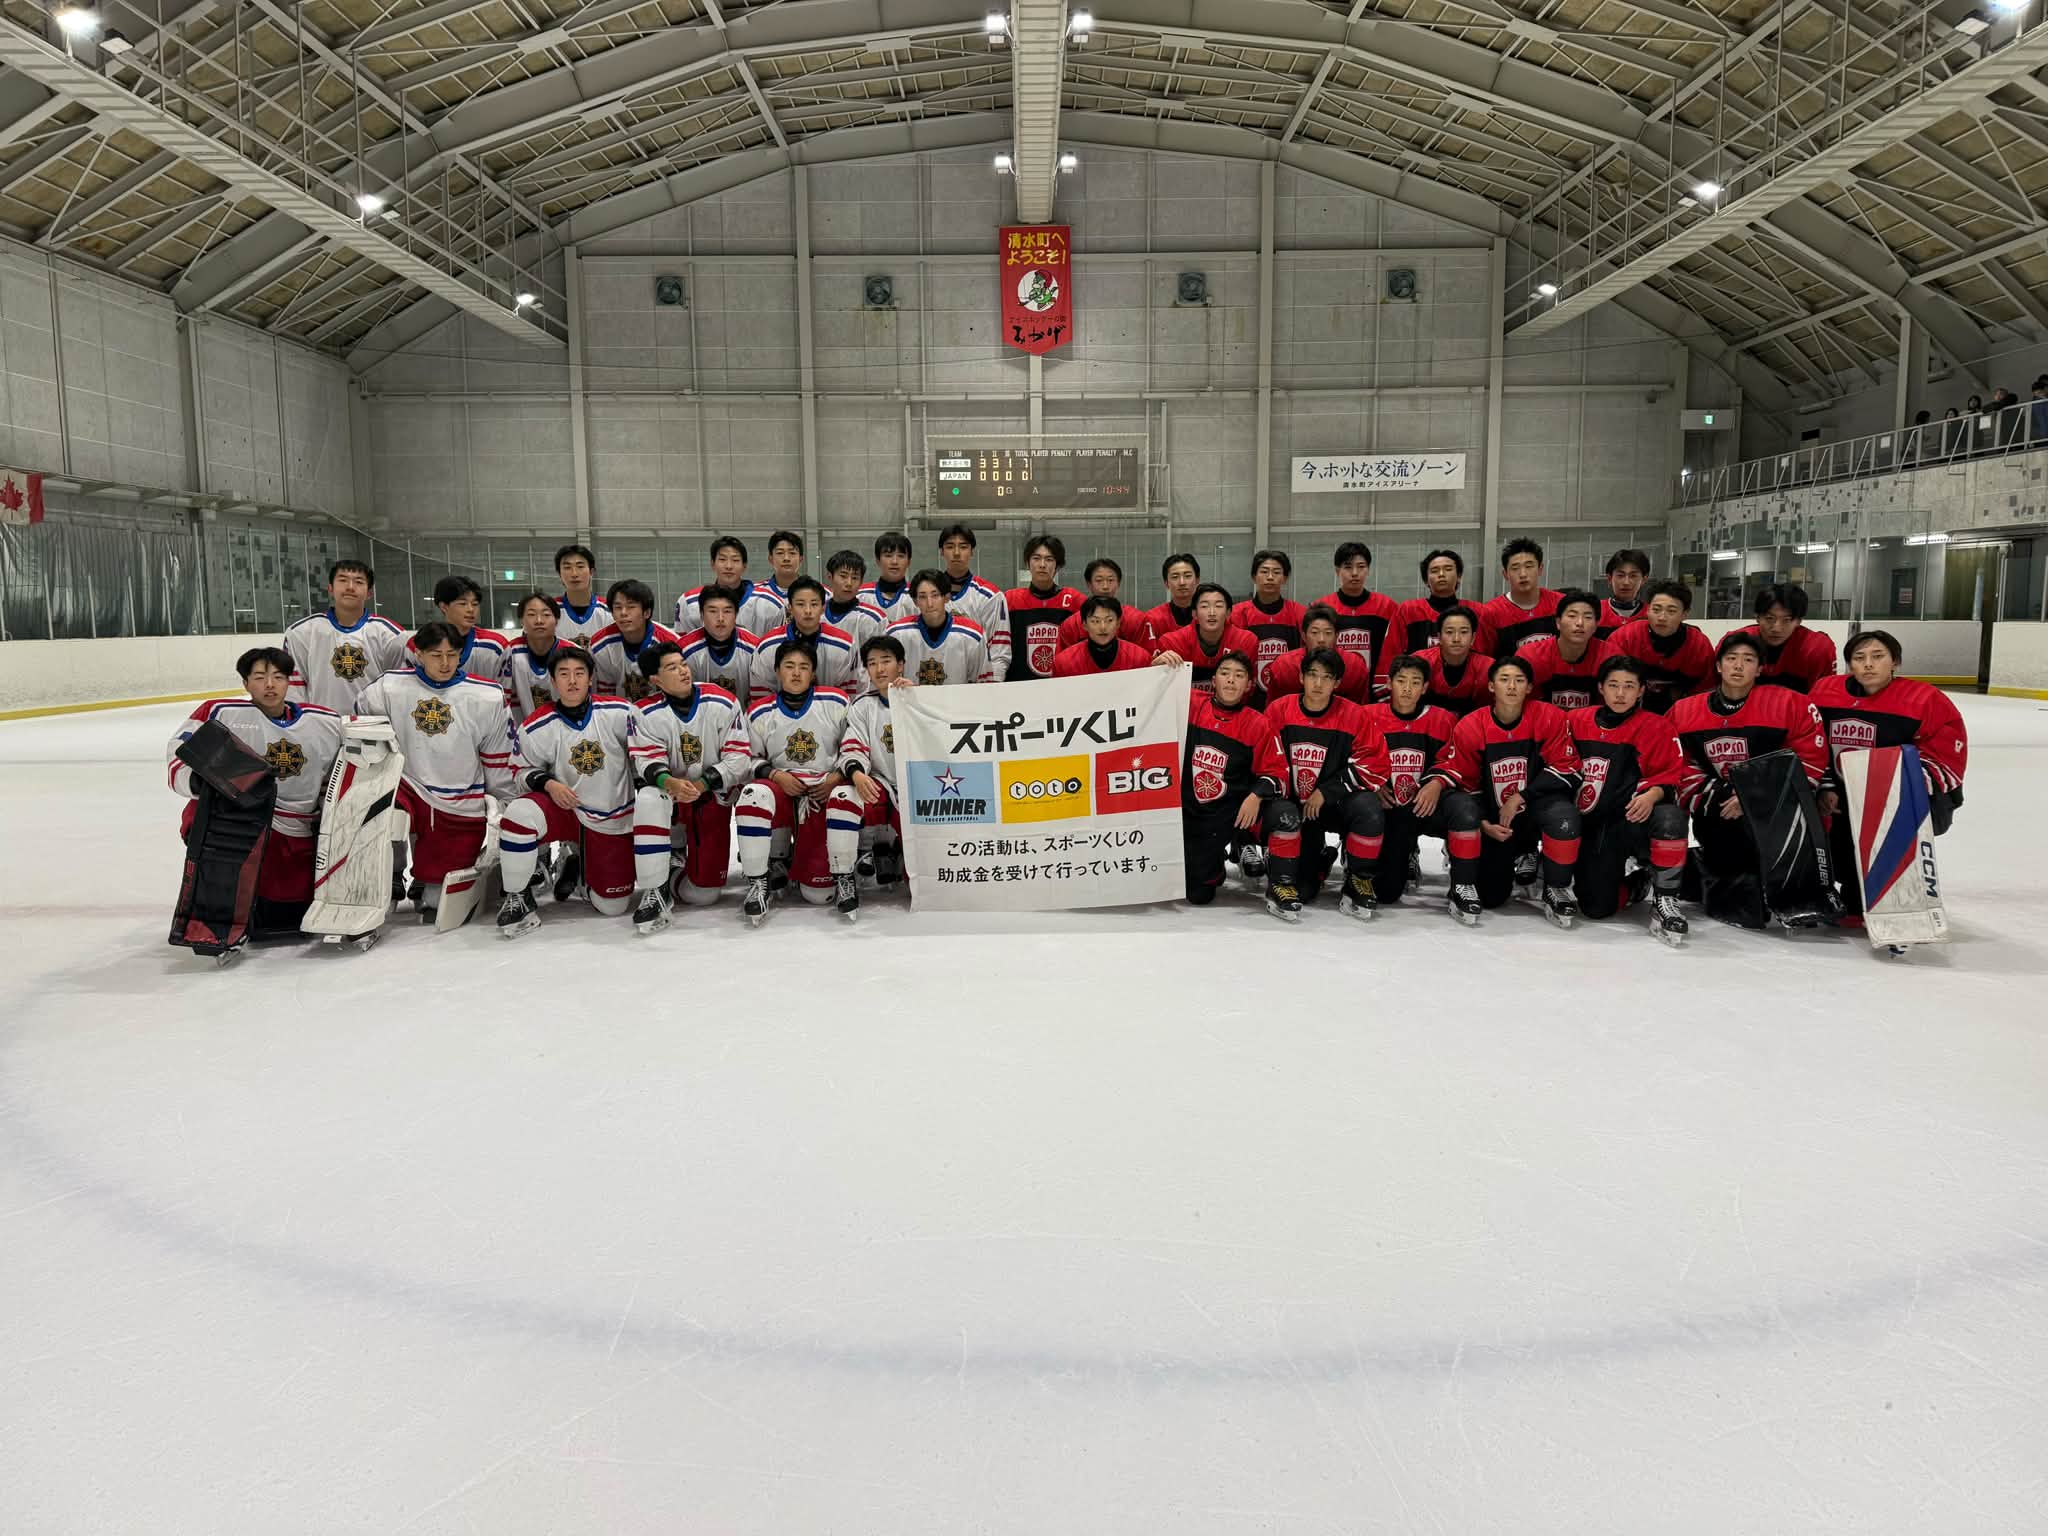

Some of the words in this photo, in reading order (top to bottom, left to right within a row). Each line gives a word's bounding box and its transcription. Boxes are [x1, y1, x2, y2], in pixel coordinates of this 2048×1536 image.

[1008, 232, 1065, 249] 清水町へ
[1031, 449, 1049, 457] PLAYER
[1051, 449, 1072, 457] PENALTY
[1076, 449, 1094, 457] PLAYER
[1095, 449, 1117, 457] PENALTY
[943, 472, 968, 480] JAPAN
[1300, 459, 1459, 480] 今、ホットな交流ゾーン
[1029, 627, 1057, 638] JAPAN
[1337, 632, 1369, 644] JAPAN
[1259, 643, 1287, 654] JAPAN
[1553, 695, 1588, 707] JAPAN
[949, 707, 1137, 754] スポーツくじ
[1834, 724, 1873, 739] JAPAN
[1292, 748, 1325, 761] JAPAN
[1709, 741, 1744, 755] JAPAN
[1195, 750, 1225, 767] JAPAN
[1391, 753, 1421, 765] JAPAN
[1009, 777, 1083, 800] toto
[1107, 767, 1171, 795] BIG
[916, 799, 987, 816] WINNER
[946, 830, 1144, 857] この活動は、スポーツくじの
[937, 856, 1159, 883] 助成金を受けて行っています。
[1920, 840, 1939, 898] CCM
